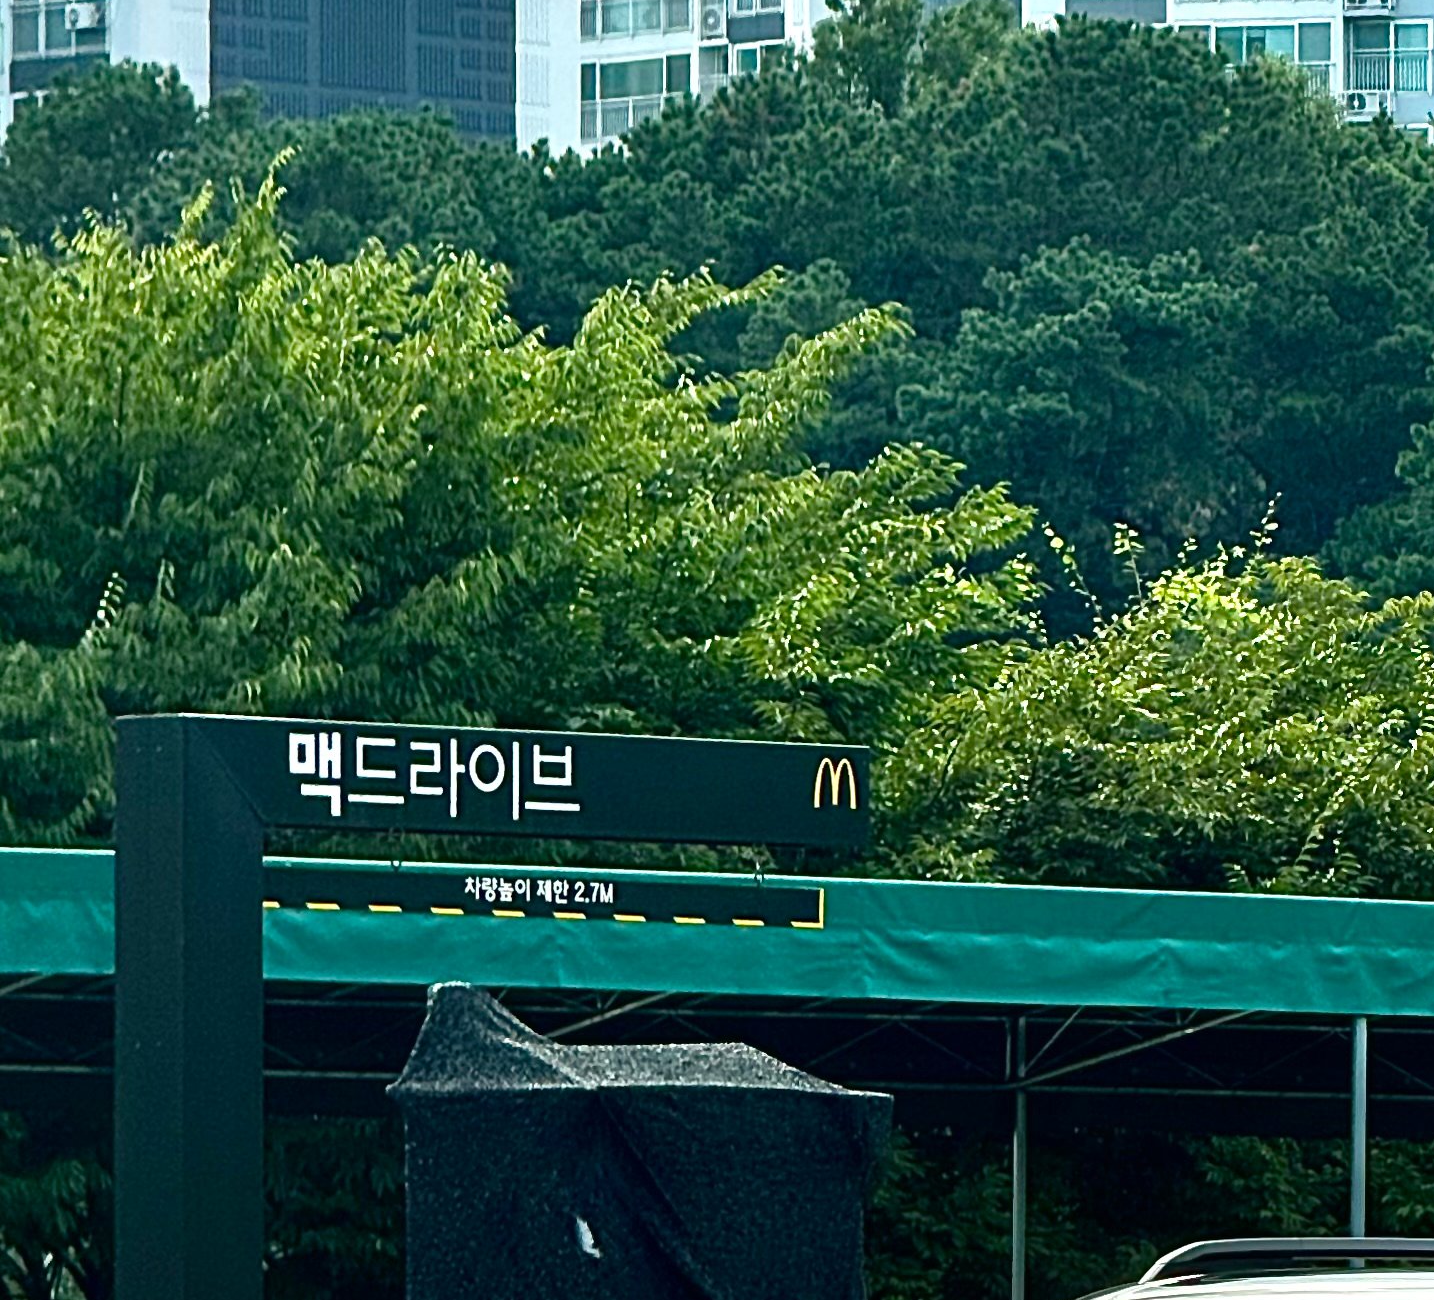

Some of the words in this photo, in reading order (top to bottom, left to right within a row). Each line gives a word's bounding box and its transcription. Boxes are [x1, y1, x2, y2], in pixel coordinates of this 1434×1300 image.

[289, 732, 581, 821] 맥드라이브
[464, 876, 531, 902] 차량높이
[536, 879, 569, 904] 제한
[574, 881, 614, 903] 2.7M
